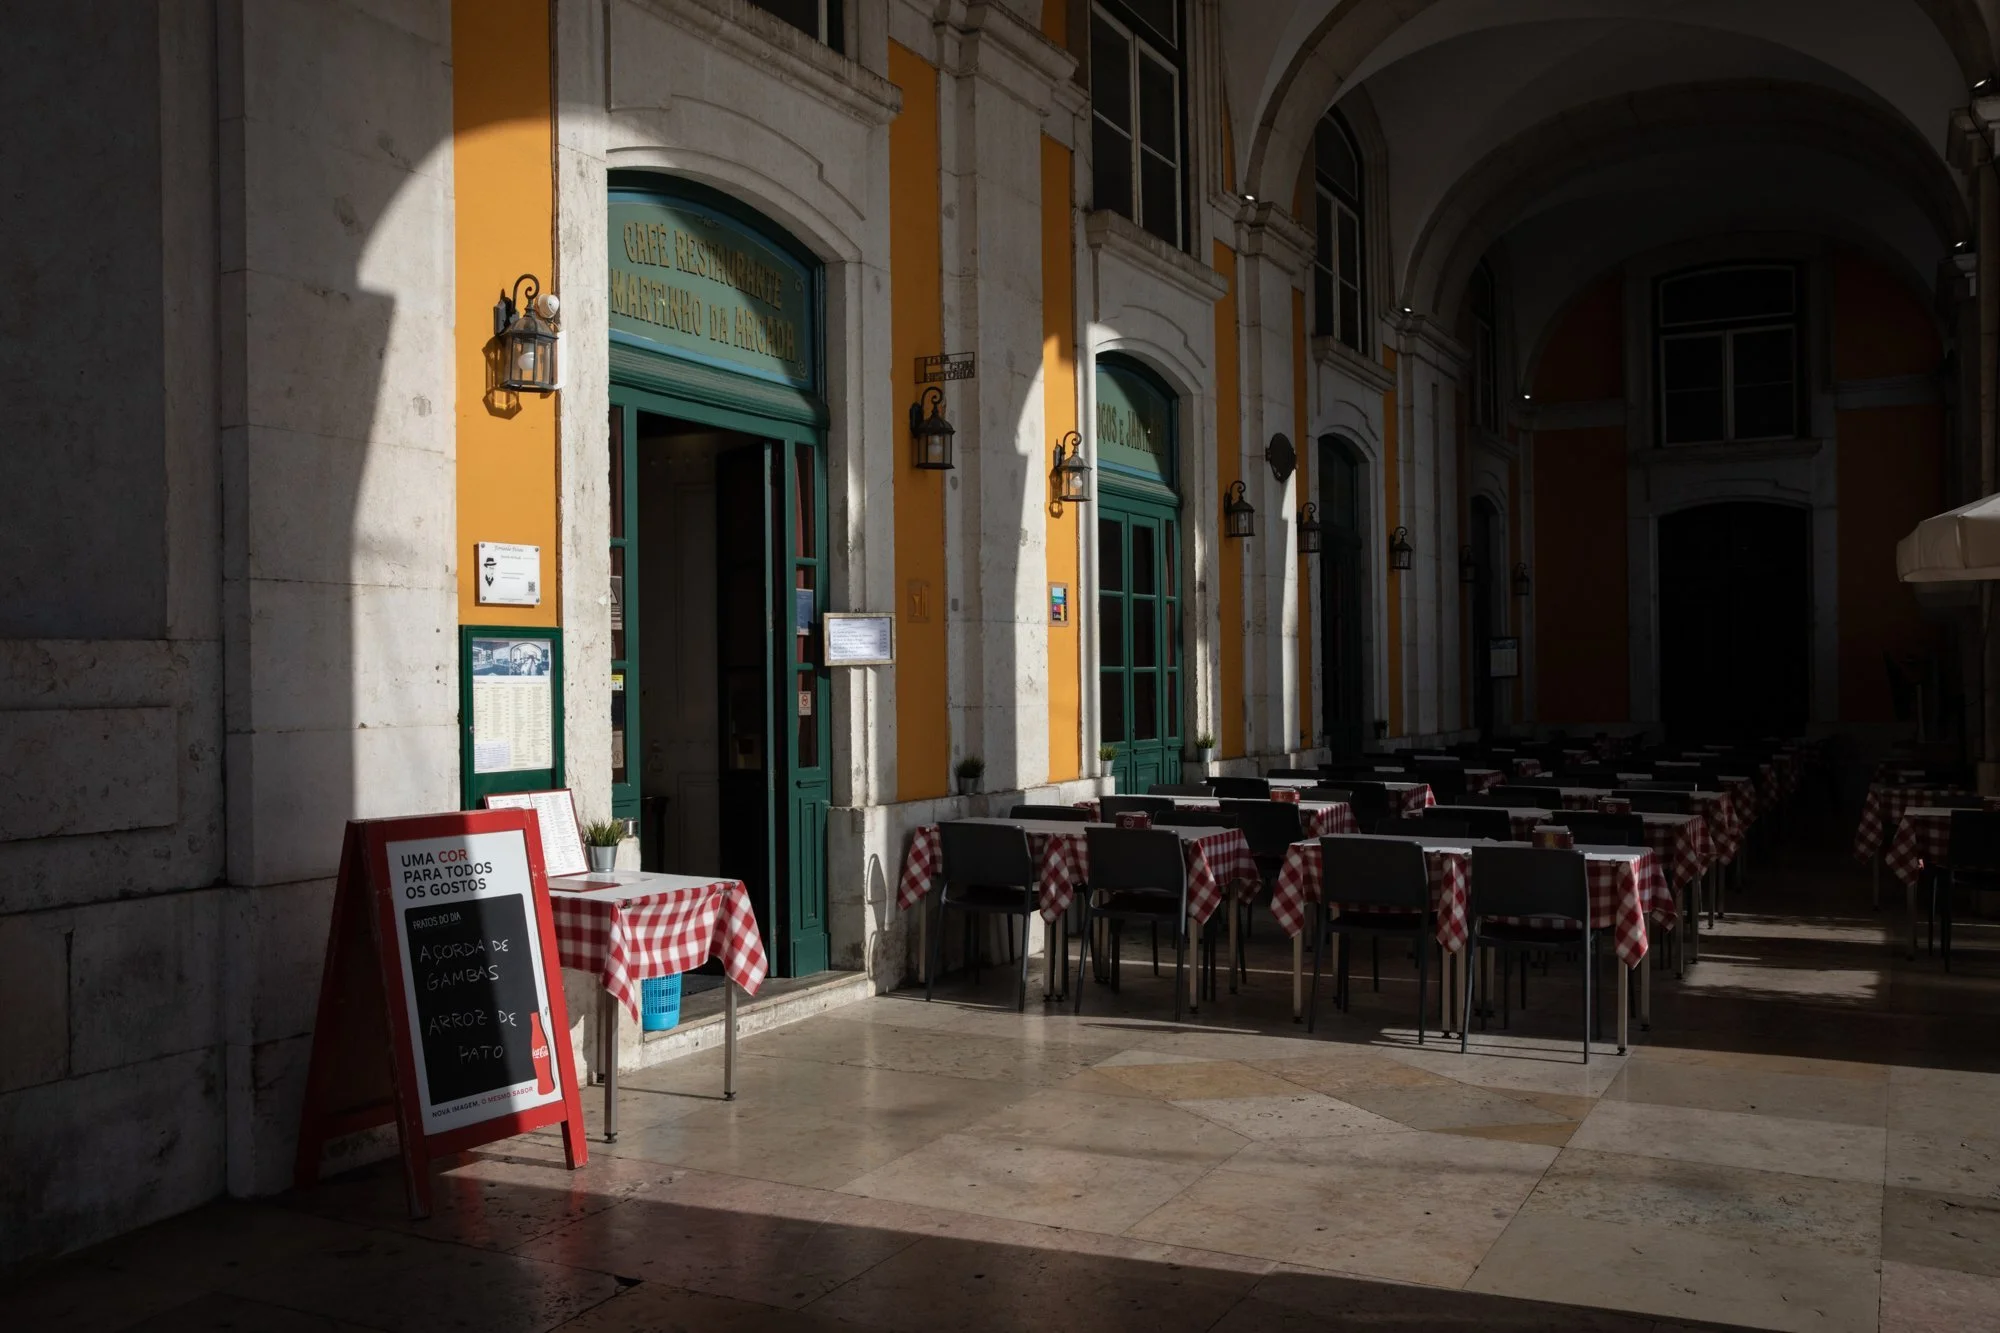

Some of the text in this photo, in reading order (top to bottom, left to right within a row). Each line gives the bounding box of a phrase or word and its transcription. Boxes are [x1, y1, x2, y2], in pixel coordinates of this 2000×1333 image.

[623, 221, 782, 311] CAFÉ RESTAURANTE
[611, 268, 796, 363] MARTINHO DA ARCADA
[1096, 402, 1117, 444] OÇOS
[401, 849, 468, 868] UMA COR
[404, 861, 493, 884] PARA TODOS
[405, 878, 487, 900] OS GOSTOS
[412, 911, 461, 930] PRATOS DO DIA
[492, 939, 509, 952] DE
[426, 964, 499, 991] GAMBAS
[428, 1009, 517, 1037] ARROZ DE
[432, 1107, 451, 1119] NOVA
[487, 1092, 511, 1103] MESMO
[512, 1086, 534, 1097] SABOR
